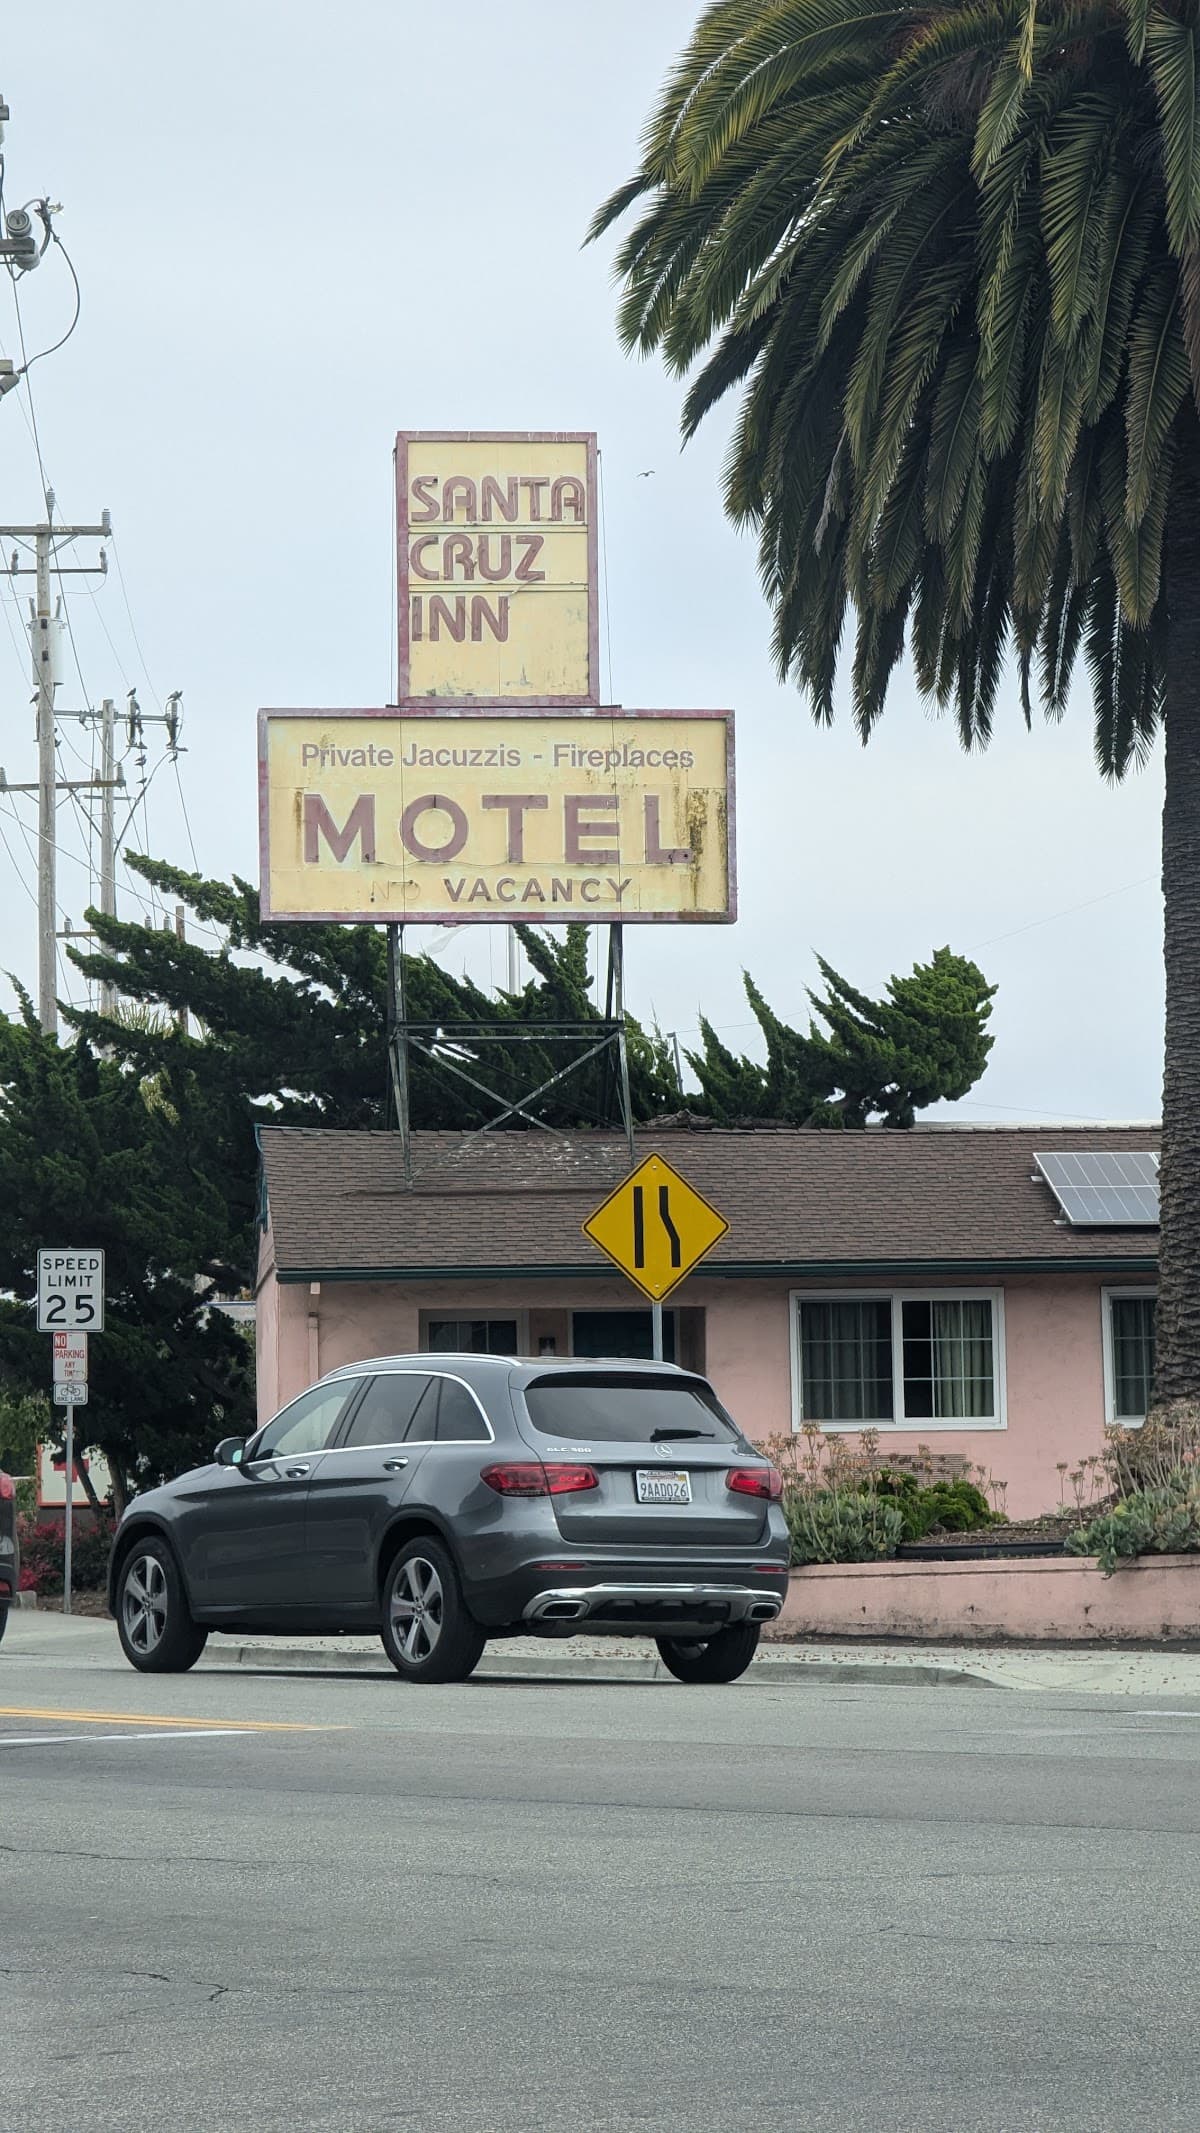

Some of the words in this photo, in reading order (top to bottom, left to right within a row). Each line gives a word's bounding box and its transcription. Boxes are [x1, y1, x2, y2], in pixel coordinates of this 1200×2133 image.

[410, 475, 586, 522] SANTA
[410, 533, 546, 581] CRUZ
[411, 594, 509, 642] INN
[302, 743, 394, 767] Private
[402, 743, 521, 767] Jacuzzis
[553, 743, 694, 771] Fireplaces
[303, 793, 694, 864] MOTEL
[443, 877, 632, 903] VACANCY
[43, 1258, 99, 1271] SPEED
[48, 1275, 94, 1287] LIMIT
[46, 1294, 95, 1324] 25
[54, 1335, 66, 1347] NO
[55, 1350, 85, 1359] PARKING
